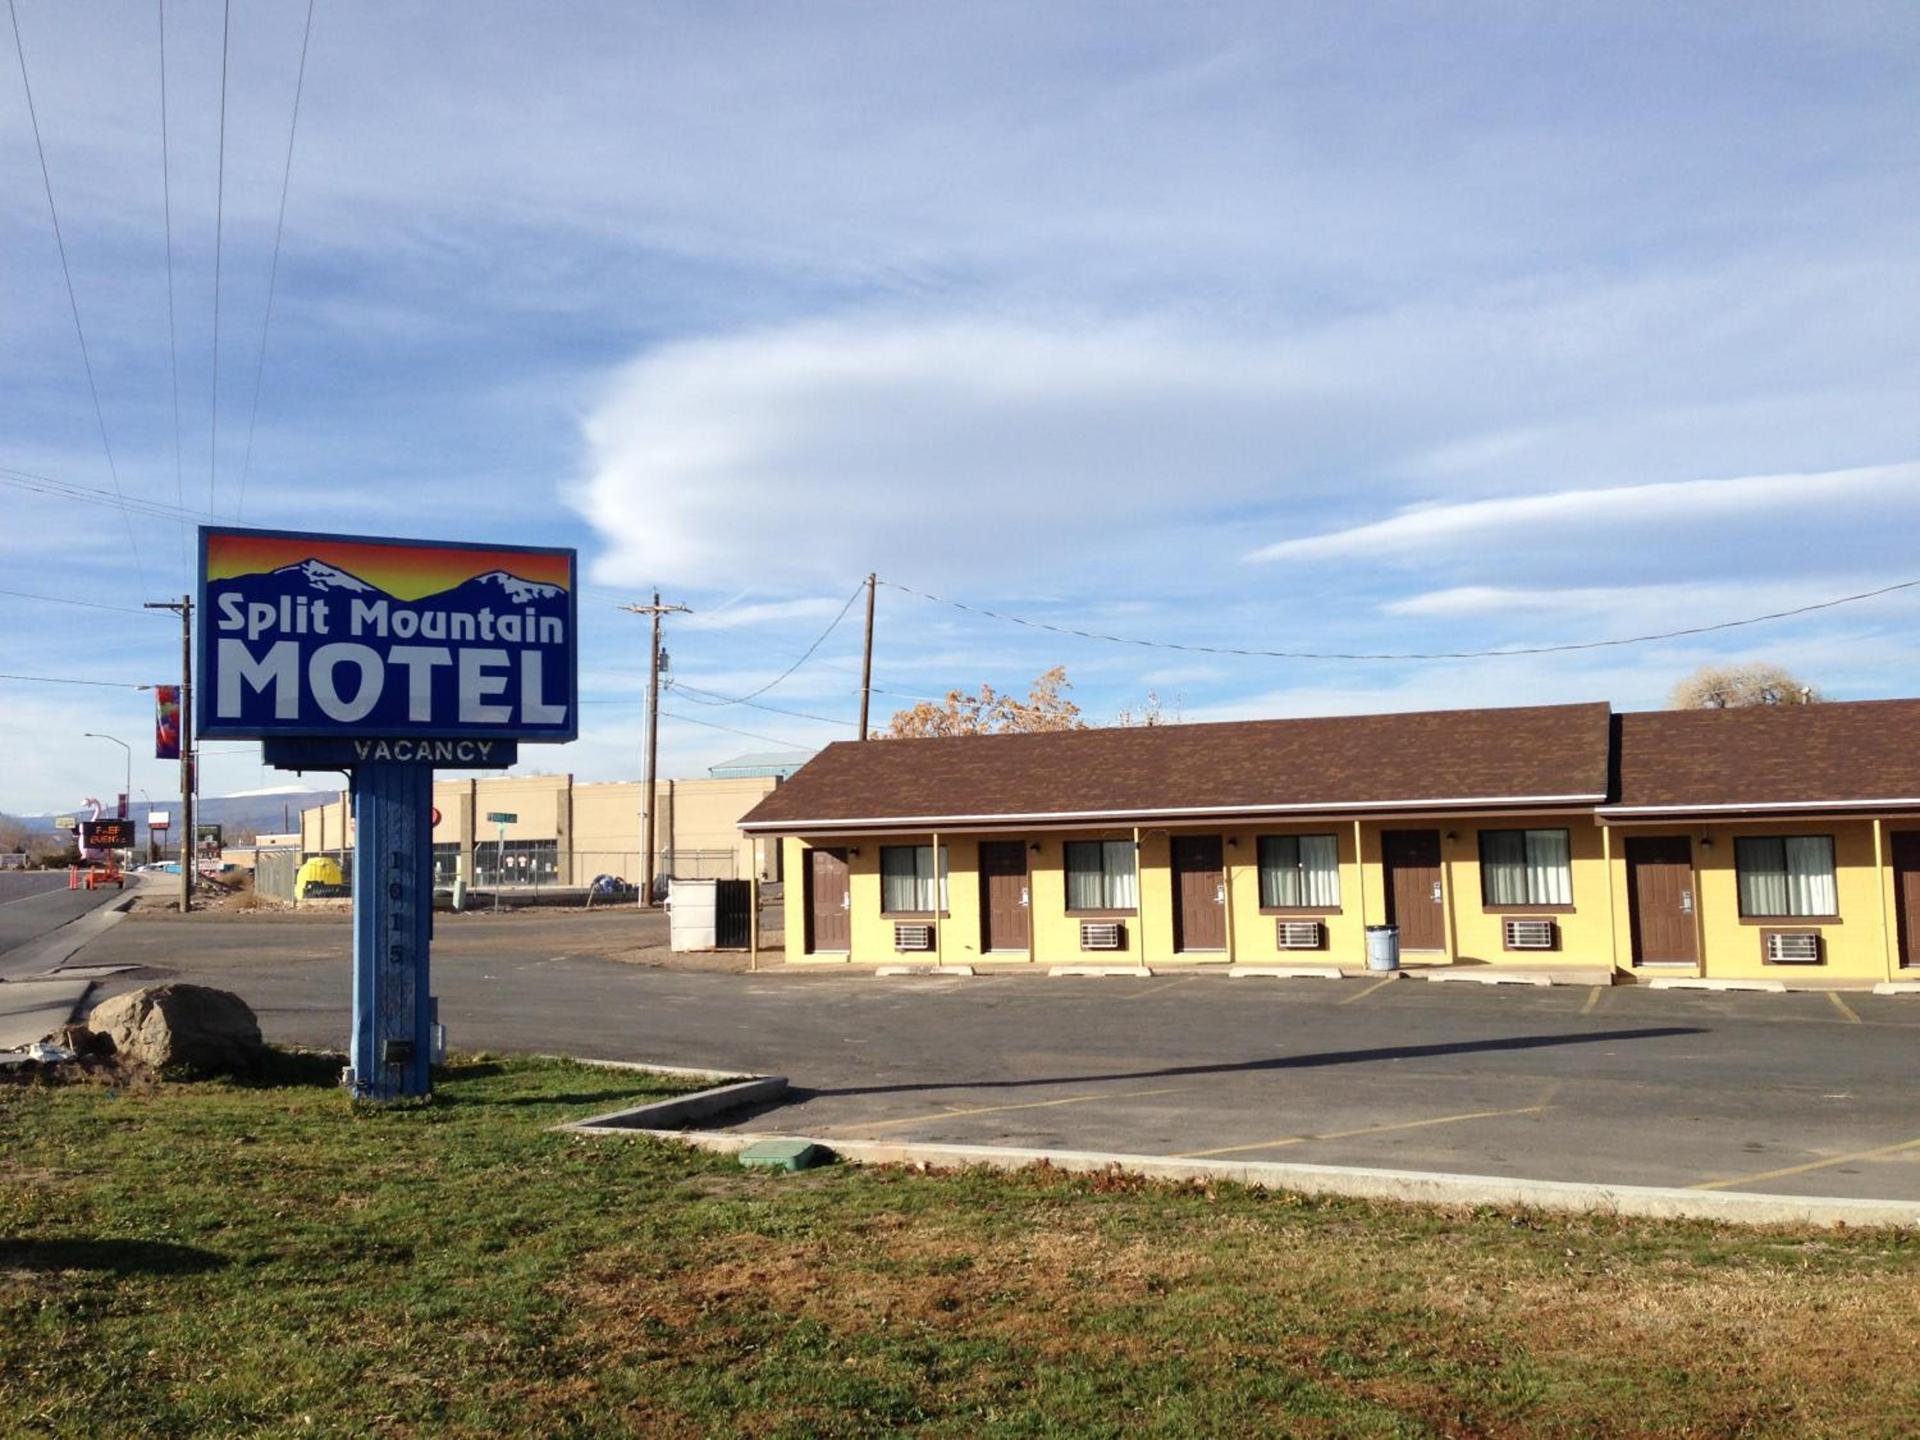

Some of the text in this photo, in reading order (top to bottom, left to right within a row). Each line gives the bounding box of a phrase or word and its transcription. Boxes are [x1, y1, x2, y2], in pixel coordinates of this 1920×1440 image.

[217, 592, 563, 643] Split Mountain
[217, 638, 567, 724] MOTEL
[354, 739, 493, 762] VACANCY
